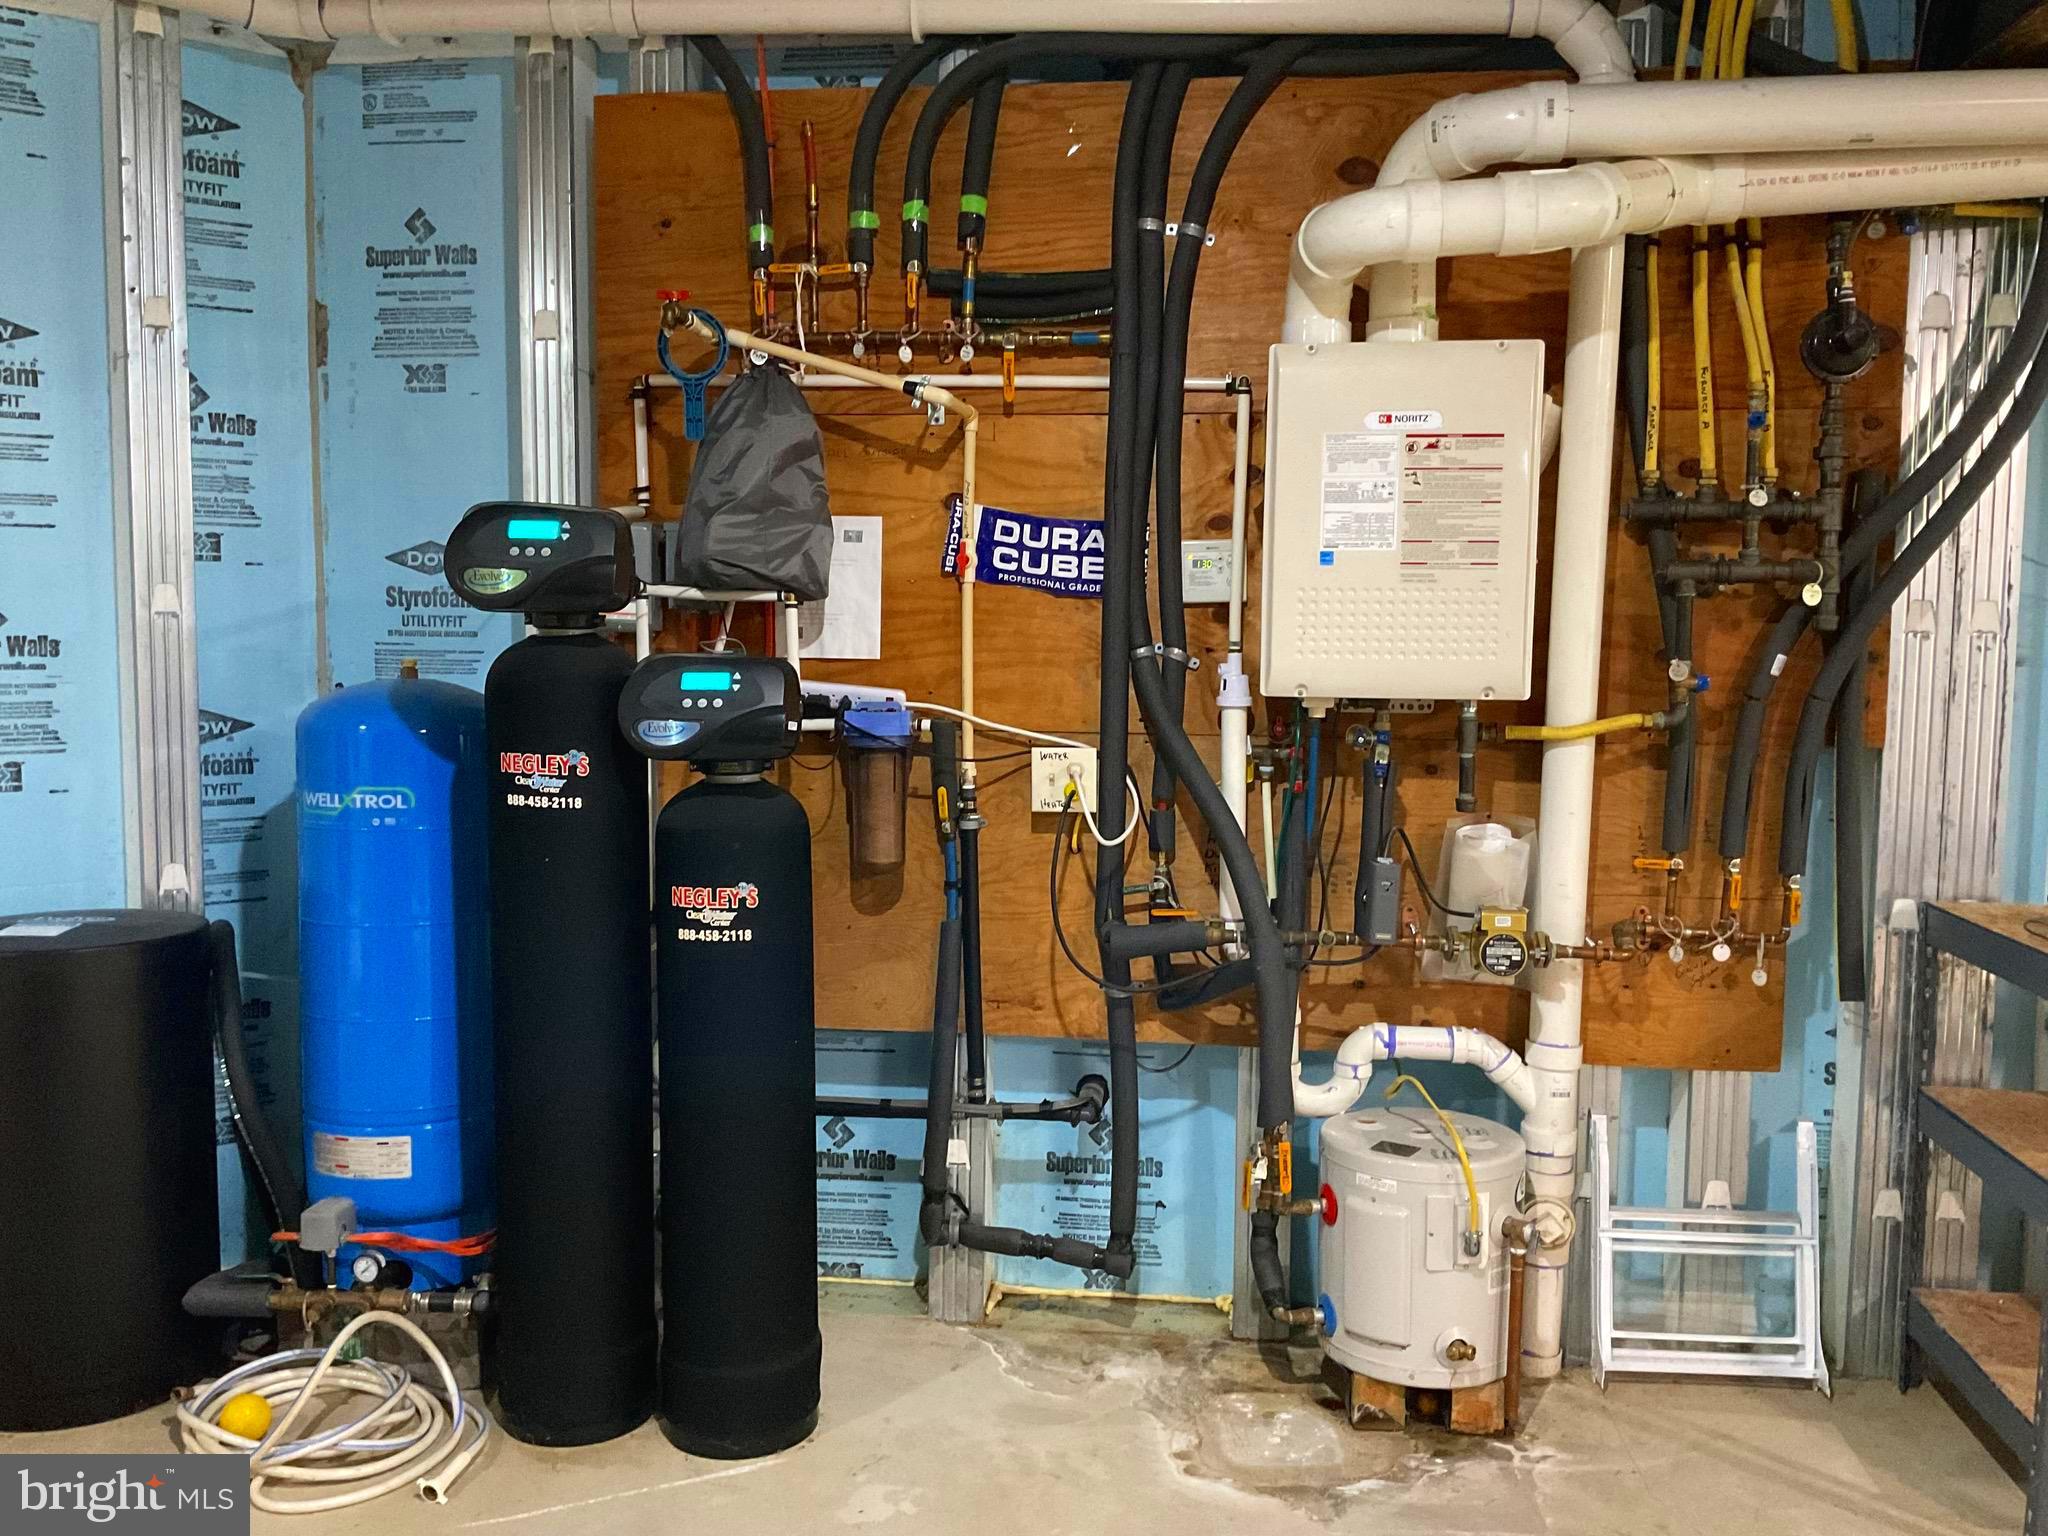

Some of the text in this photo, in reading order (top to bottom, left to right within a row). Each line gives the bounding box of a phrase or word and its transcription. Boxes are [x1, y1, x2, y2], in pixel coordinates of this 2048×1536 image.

[366, 243, 478, 269] Superior Walls
[208, 412, 256, 436] Walls
[1394, 414, 1429, 423] NORITZ
[993, 518, 1104, 552] DURA
[406, 551, 444, 567] DO
[993, 546, 1104, 580] CUBE
[998, 573, 1100, 593] PROFESSIONAL GRADE
[402, 614, 464, 628] UTILITYFIT
[6, 635, 61, 658] Walls
[507, 793, 583, 809] 888-458-2118
[678, 928, 752, 942] 888-458-2118
[853, 1149, 897, 1171] Walls
[1137, 1156, 1164, 1178] alls
